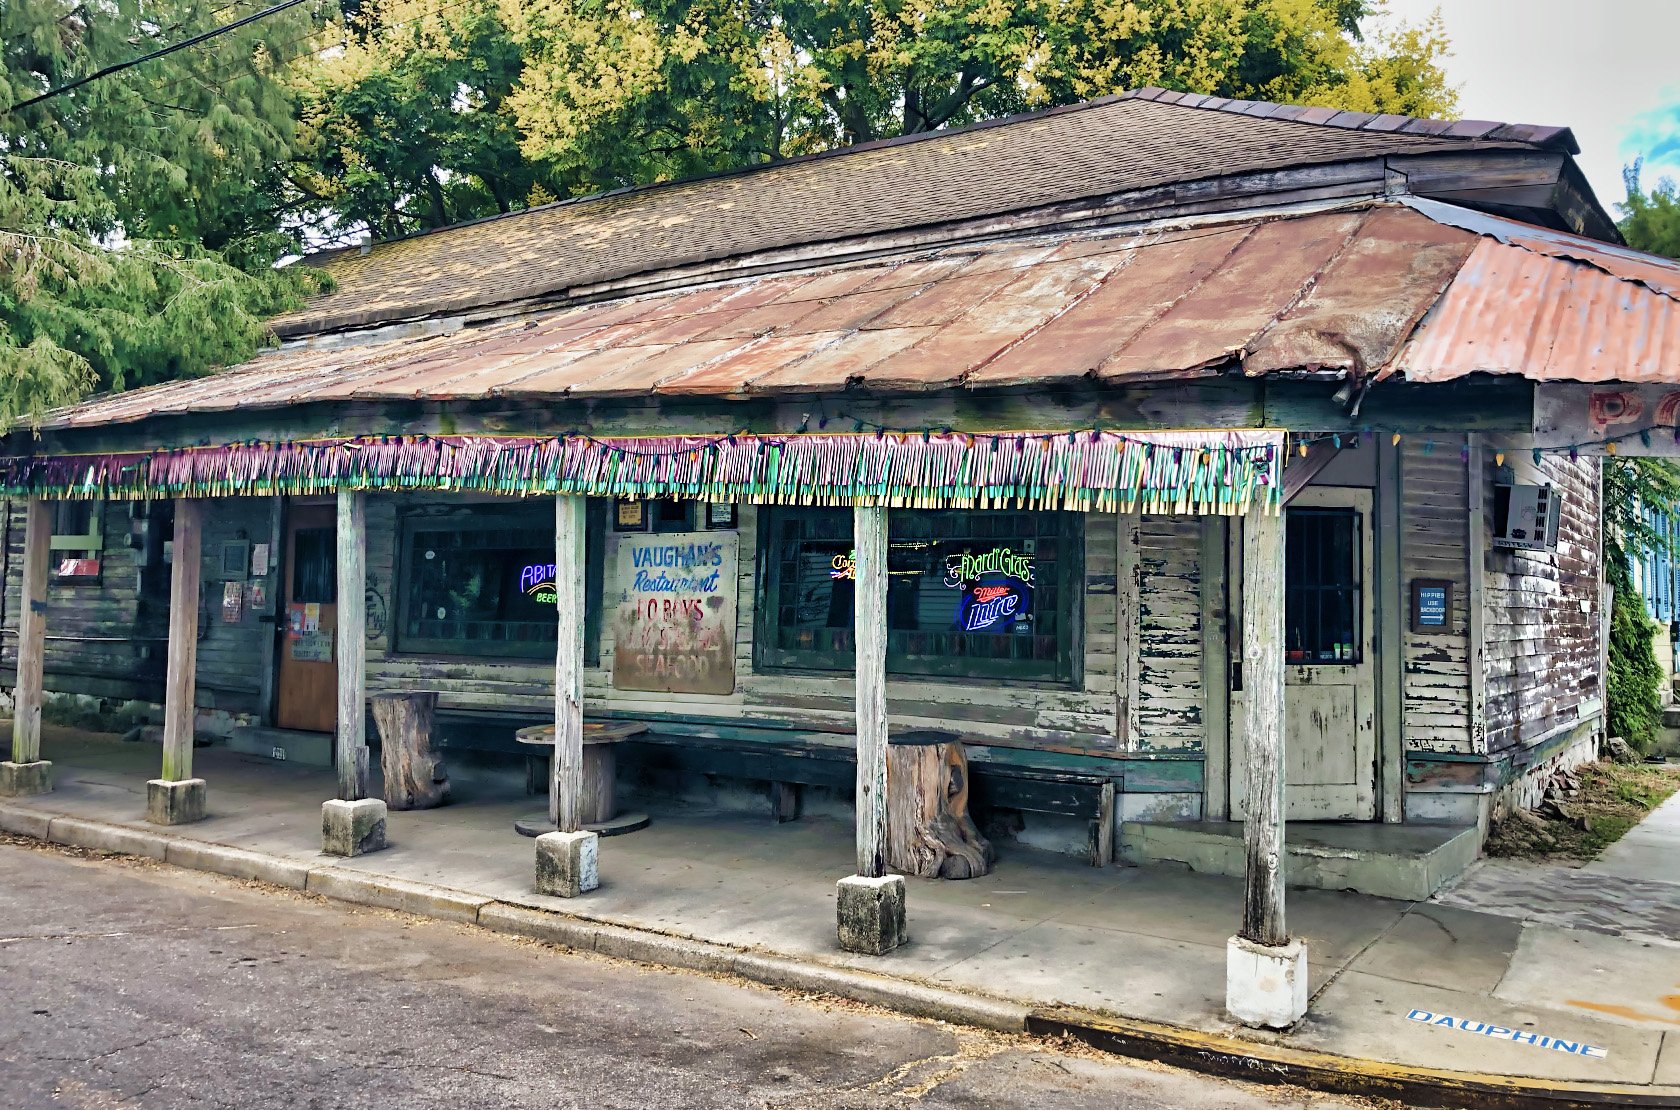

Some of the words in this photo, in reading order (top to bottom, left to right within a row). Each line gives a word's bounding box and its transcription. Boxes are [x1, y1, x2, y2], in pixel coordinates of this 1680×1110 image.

[632, 542, 723, 568] VAUGHAN'S
[961, 547, 1000, 582] Mardi
[1000, 547, 1030, 582] Gras
[632, 569, 720, 593] Restaurant
[536, 592, 558, 604] BEER
[973, 586, 1011, 602] Miller
[1407, 1009, 1607, 1059] DAUPHINE
